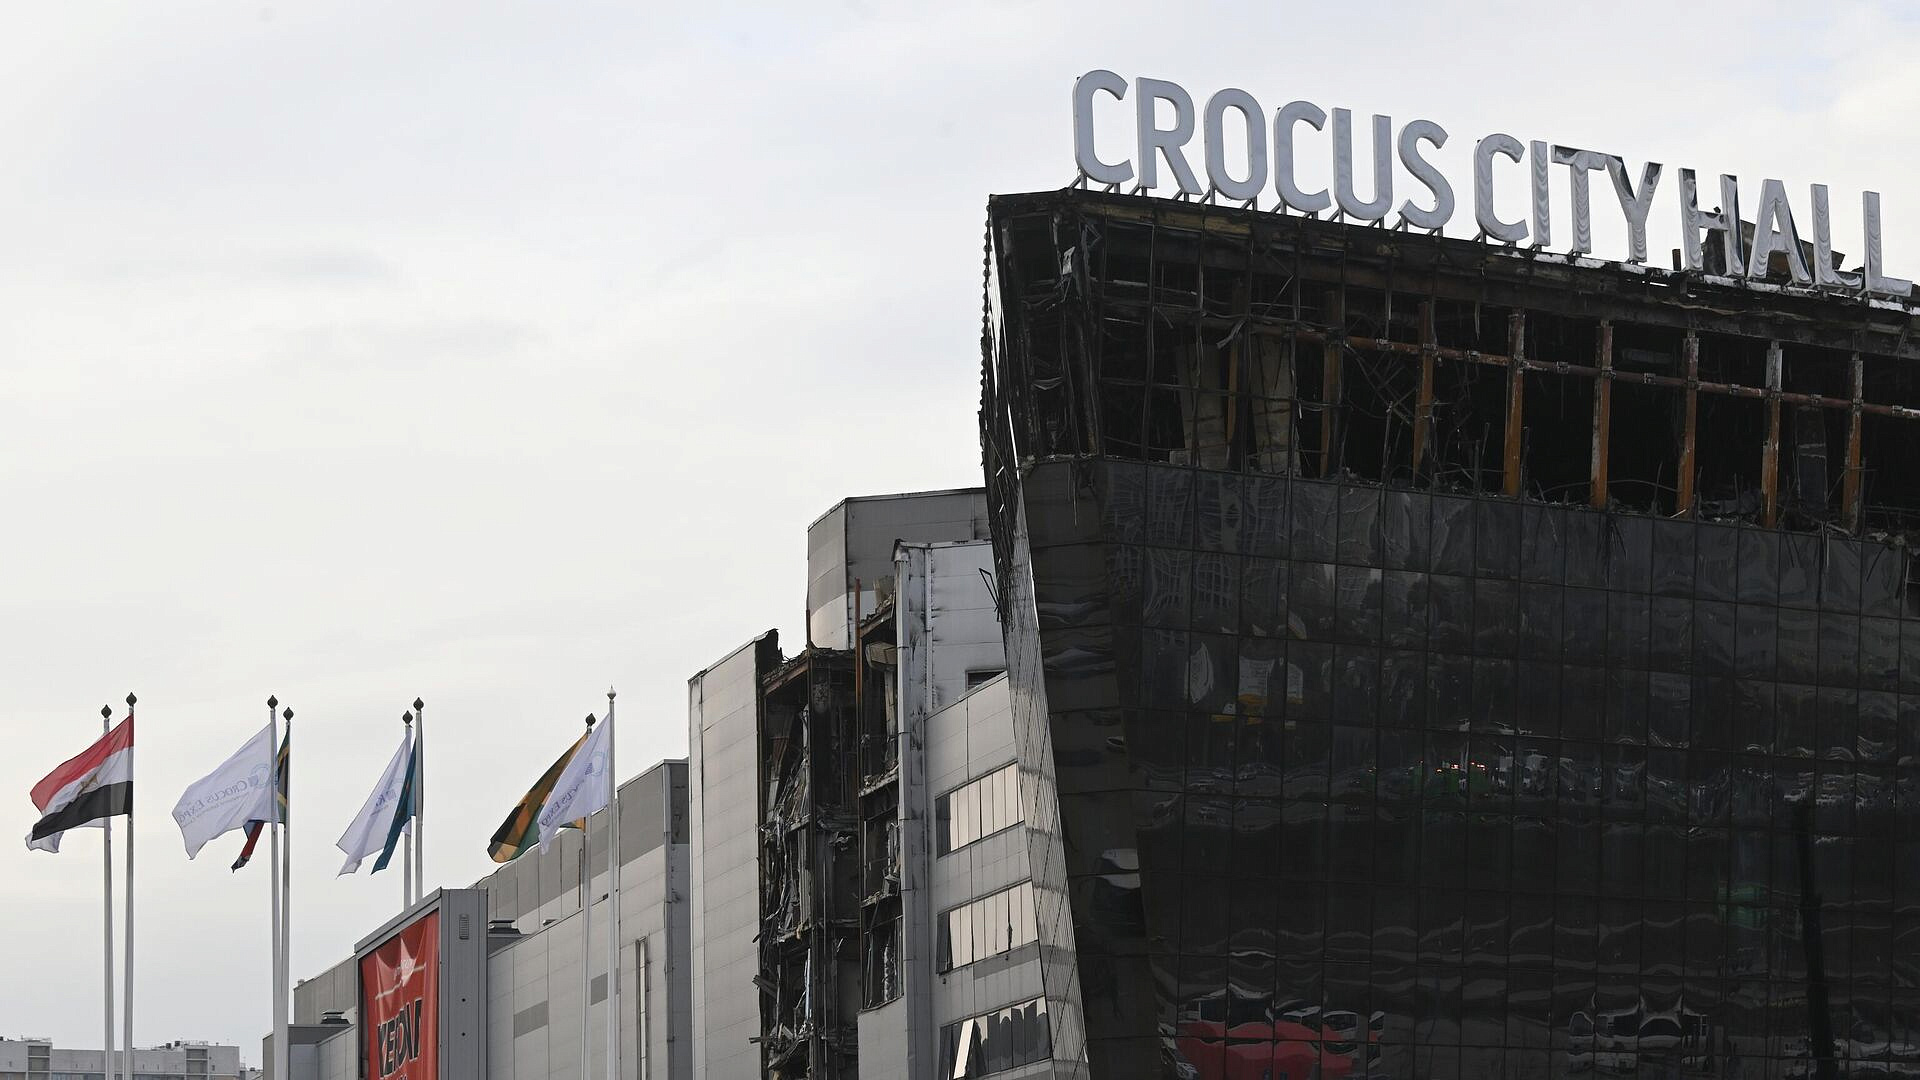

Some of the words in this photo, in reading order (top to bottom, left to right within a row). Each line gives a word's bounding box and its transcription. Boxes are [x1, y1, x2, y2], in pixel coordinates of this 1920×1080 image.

[1073, 69, 1455, 230] CROCUS
[1474, 133, 1663, 263] CITY
[1678, 168, 1913, 297] HALL
